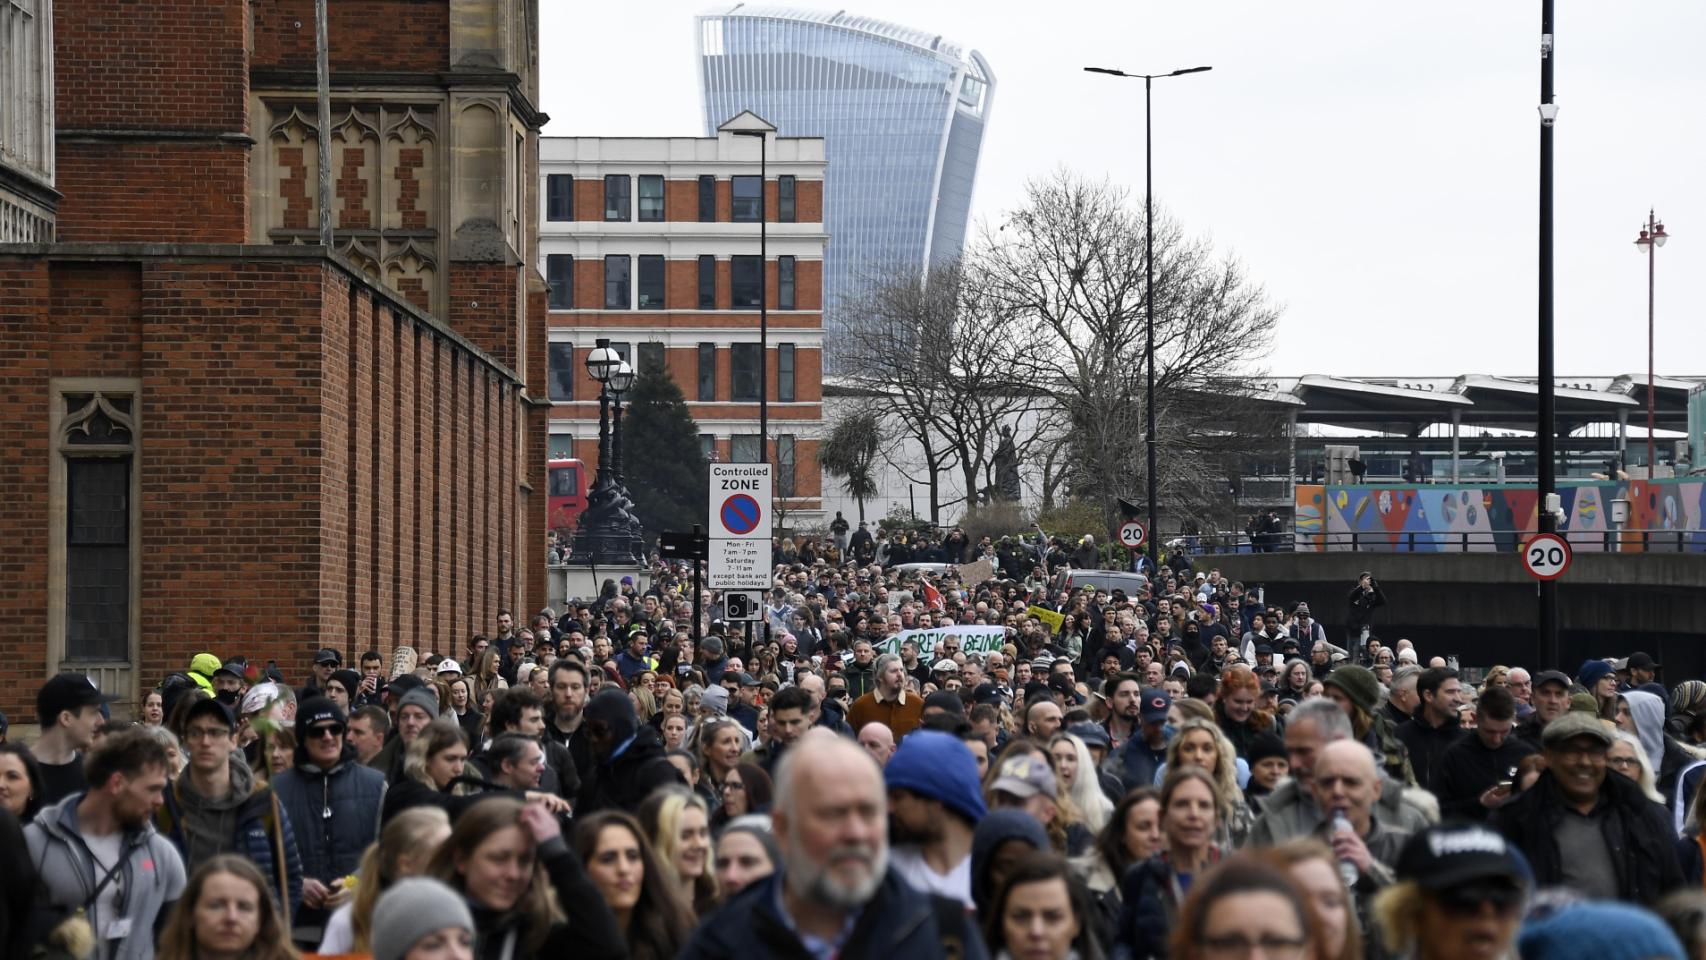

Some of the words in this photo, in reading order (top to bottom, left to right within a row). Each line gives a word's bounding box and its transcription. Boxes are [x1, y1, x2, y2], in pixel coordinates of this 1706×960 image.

[713, 467, 768, 476] Controlled
[721, 479, 759, 490] ZONE
[1123, 528, 1142, 540] 20
[1531, 547, 1564, 567] 20
